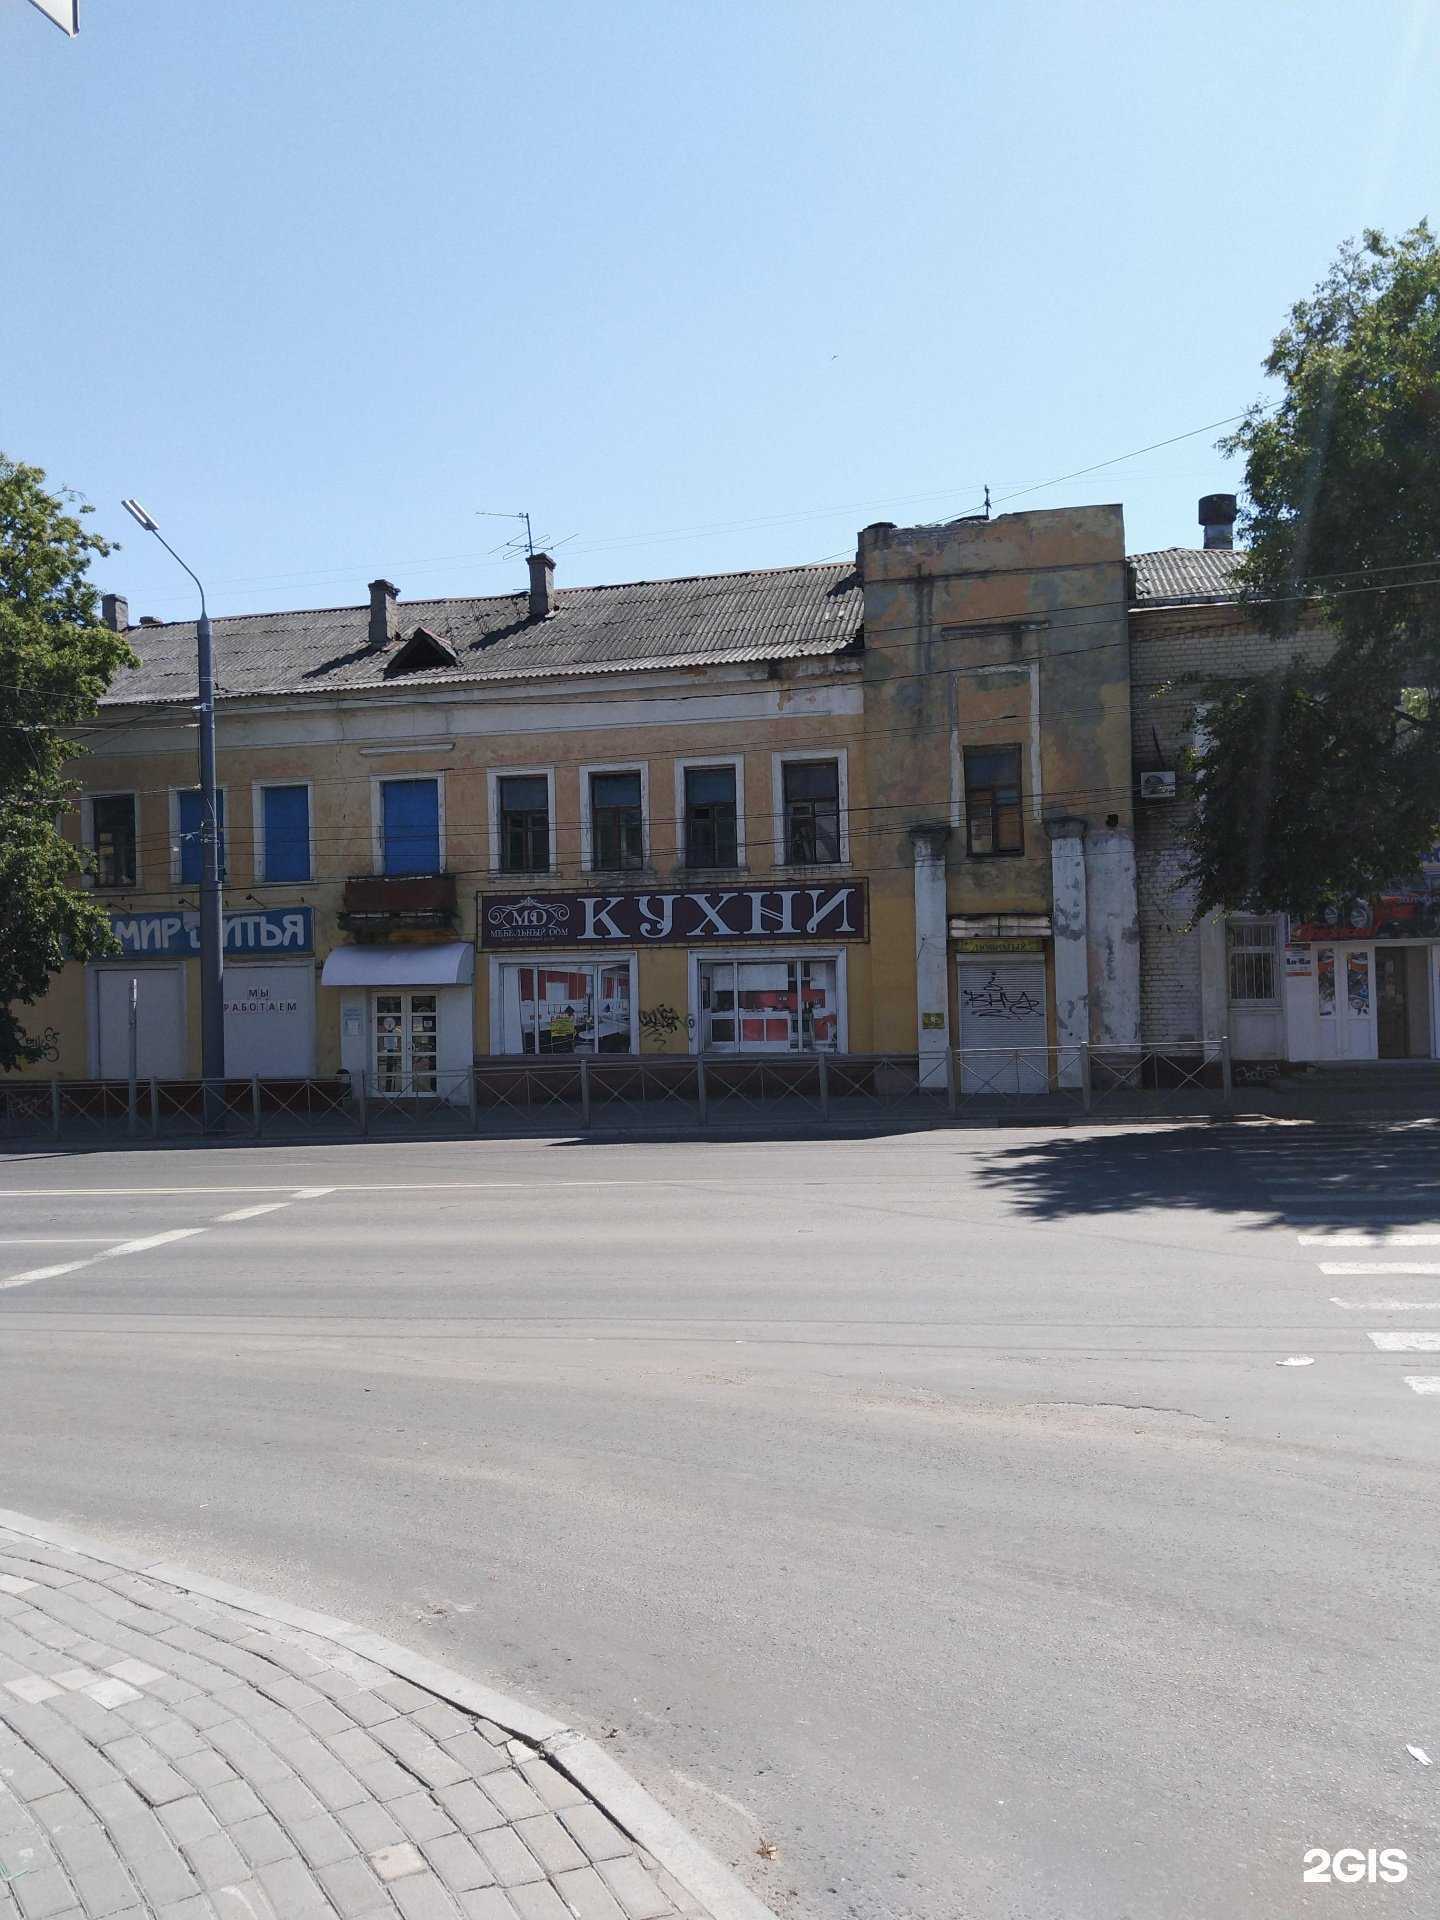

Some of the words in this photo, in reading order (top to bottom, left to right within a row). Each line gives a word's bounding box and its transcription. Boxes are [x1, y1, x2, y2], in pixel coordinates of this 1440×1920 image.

[576, 888, 857, 940] КУХНИ
[115, 917, 181, 951] МИР
[248, 989, 269, 998] МЫ
